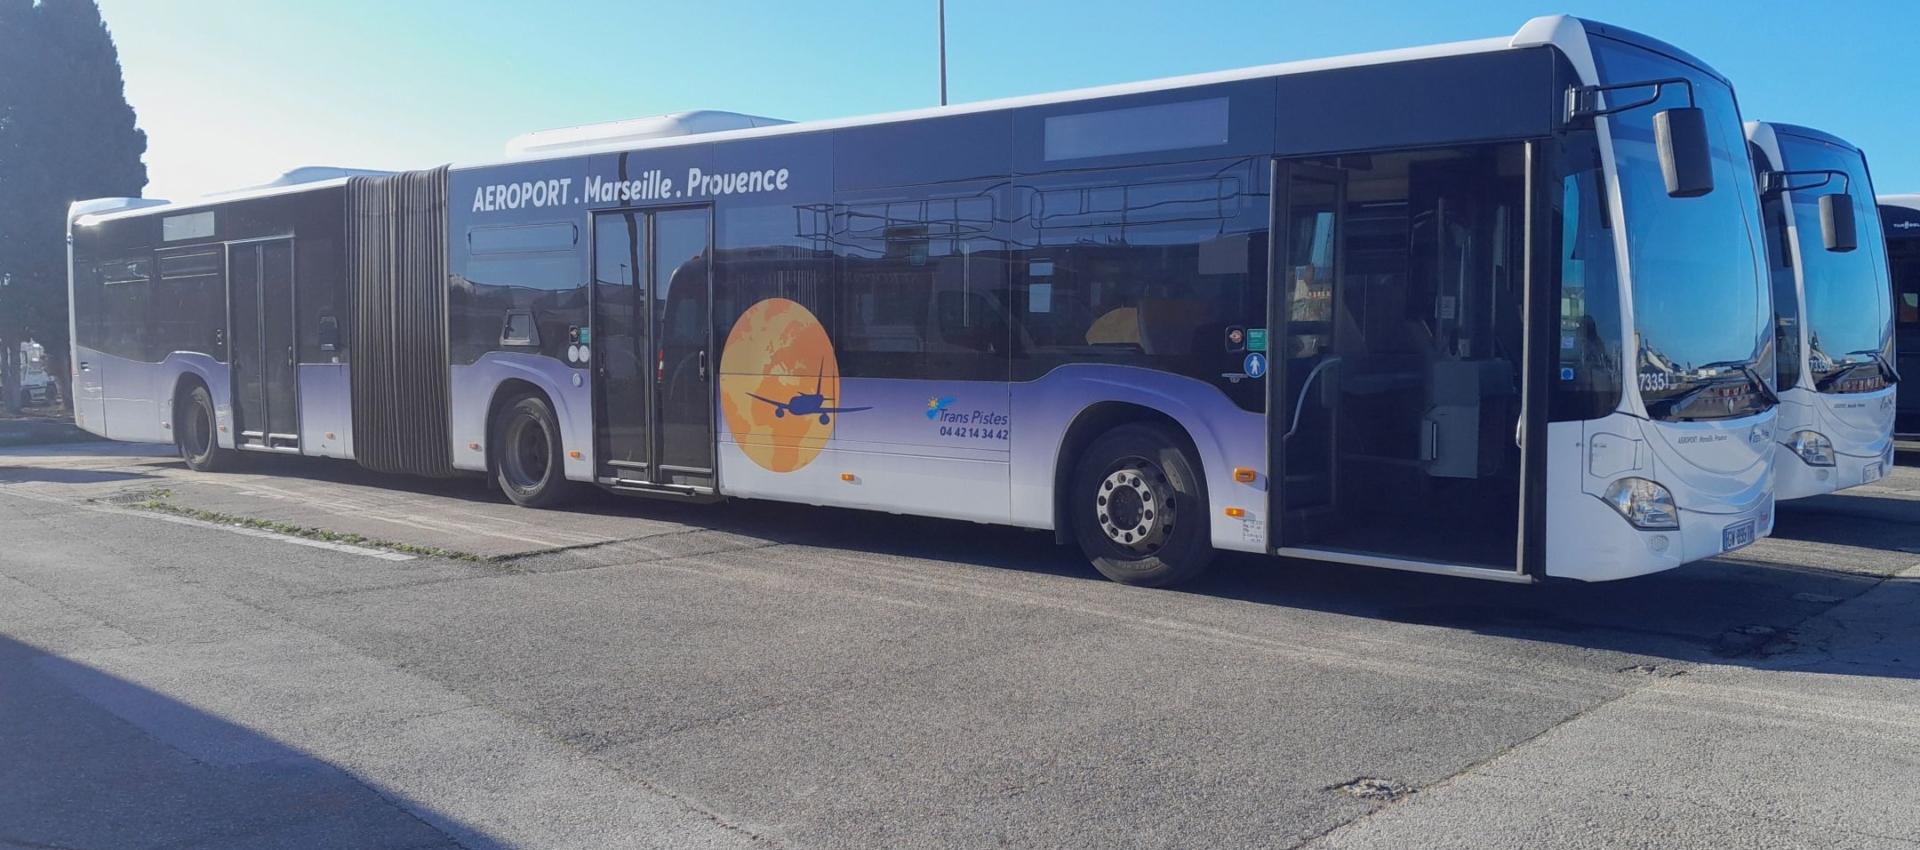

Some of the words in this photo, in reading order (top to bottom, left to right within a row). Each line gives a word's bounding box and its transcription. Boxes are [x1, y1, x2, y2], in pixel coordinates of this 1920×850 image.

[472, 178, 572, 212] AEROPORT
[584, 169, 672, 203] Marseille
[687, 167, 789, 197] Provence
[939, 408, 969, 423] Trans
[971, 410, 1008, 425] Pistes
[940, 426, 952, 436] 04
[954, 427, 966, 438] 42
[968, 427, 979, 438] 14
[982, 428, 994, 439] 34
[996, 429, 1009, 440] 42
